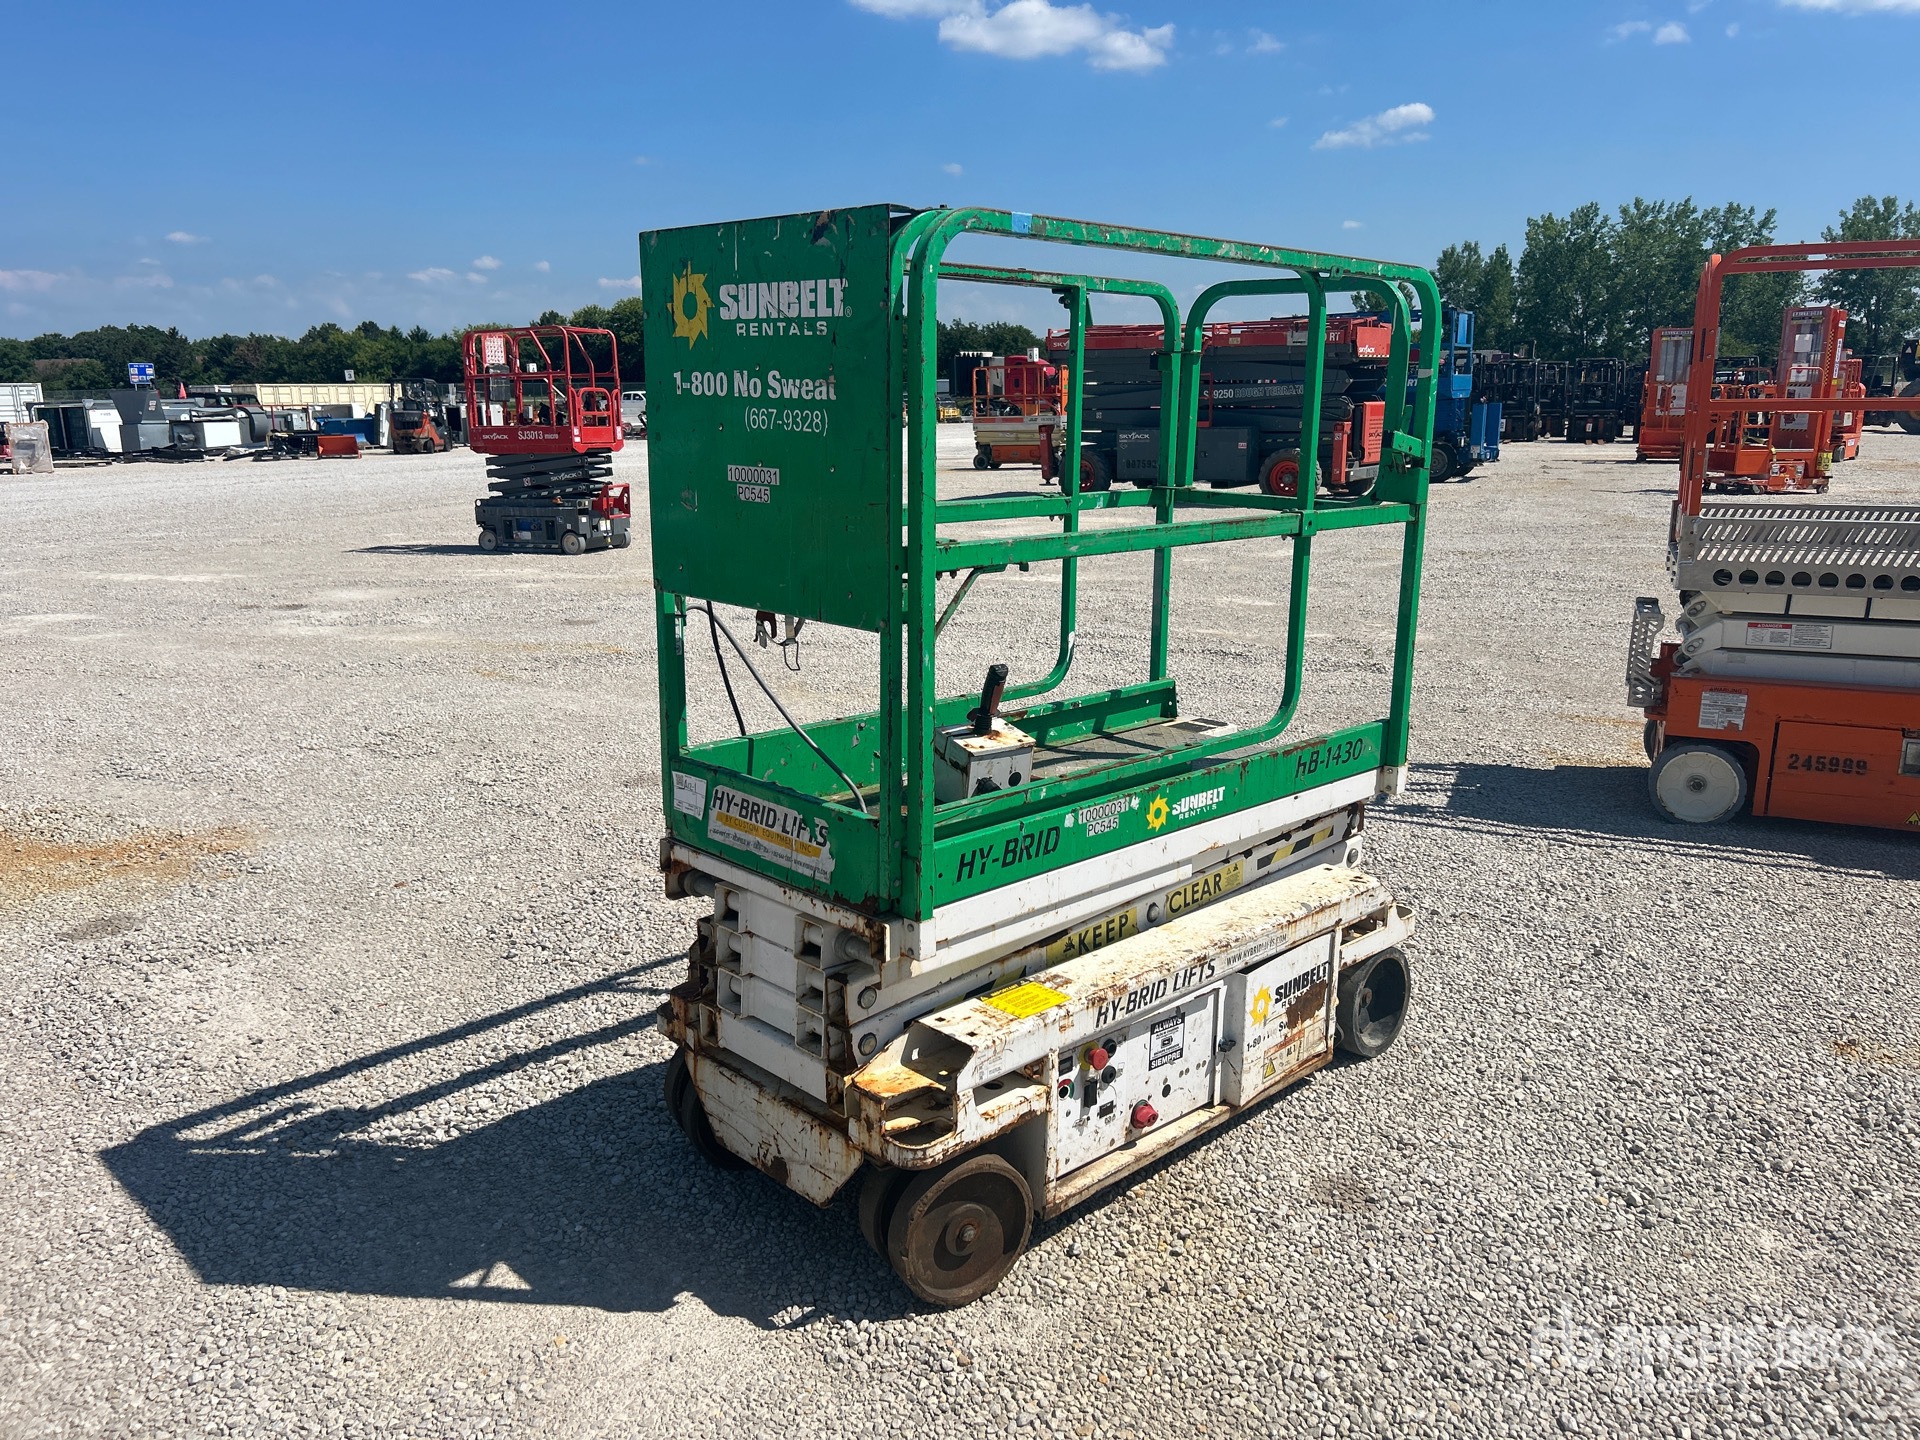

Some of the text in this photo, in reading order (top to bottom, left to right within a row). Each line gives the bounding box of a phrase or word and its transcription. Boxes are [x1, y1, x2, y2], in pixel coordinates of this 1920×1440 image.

[719, 278, 848, 320] SUNBELT
[736, 320, 828, 337] RENTALS
[347, 371, 353, 380] 3
[674, 370, 836, 400] 1-800 No Sweat
[1203, 388, 1234, 399] S9250
[744, 406, 828, 437] (667-9328)
[518, 431, 543, 440] SJ3013
[1119, 432, 1150, 440] SKYJACK
[728, 467, 778, 485] 10000031
[738, 487, 769, 502] PC545
[711, 788, 777, 830] HY-BRID
[1079, 801, 1128, 824] 10000031
[1172, 786, 1224, 816] SUNBELT
[725, 814, 733, 824] BY
[734, 817, 760, 834] CUSTOM
[800, 842, 812, 854] INC
[1087, 817, 1119, 836] PC545
[956, 826, 1061, 883] HY-BRID
[1078, 872, 1222, 956] KEEP CLEAR
[1095, 977, 1168, 1029] HY-BRID
[1172, 957, 1217, 993] LIFTS
[1274, 961, 1330, 1005] SUNBELT
[1154, 1017, 1182, 1033] ALWAYS
[1151, 1050, 1181, 1069] SIEMPRE
